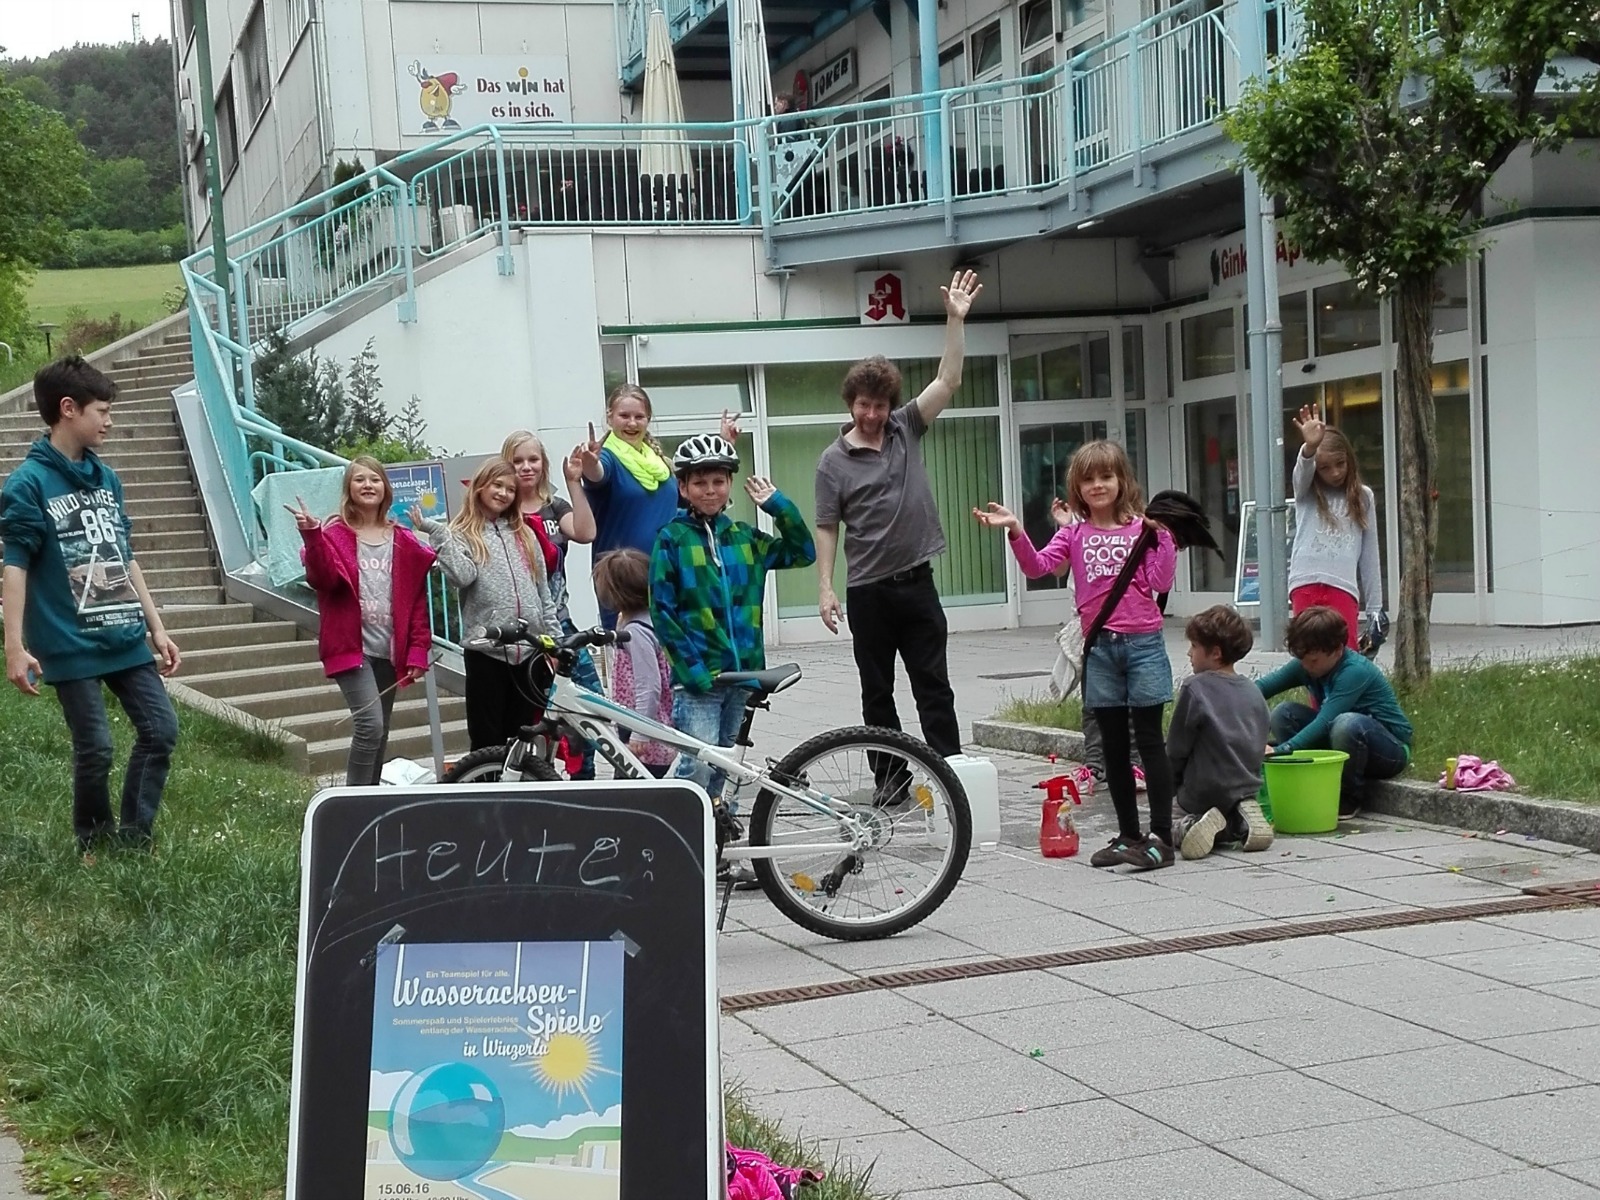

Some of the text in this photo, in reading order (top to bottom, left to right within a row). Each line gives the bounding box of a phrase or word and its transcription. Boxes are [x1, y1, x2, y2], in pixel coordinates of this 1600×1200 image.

[477, 78, 501, 94] Das
[543, 78, 565, 93] hat
[491, 101, 555, 118] es in sich.
[1220, 243, 1248, 280] Gink
[46, 493, 81, 522] WILD
[80, 507, 117, 545] 86
[1082, 535, 1139, 548] LOVELY
[580, 720, 648, 779] CON
[426, 971, 439, 979] Ein
[440, 969, 480, 980] Teamspiel
[481, 969, 493, 978] für
[393, 977, 576, 1008] Wasserachsen-
[420, 1026, 450, 1036] entlang
[450, 1026, 464, 1034] der
[446, 1016, 462, 1025] und
[527, 1005, 603, 1041] Spiele
[463, 1035, 550, 1061] in Winzerla
[378, 1183, 430, 1195] 15.06.16
